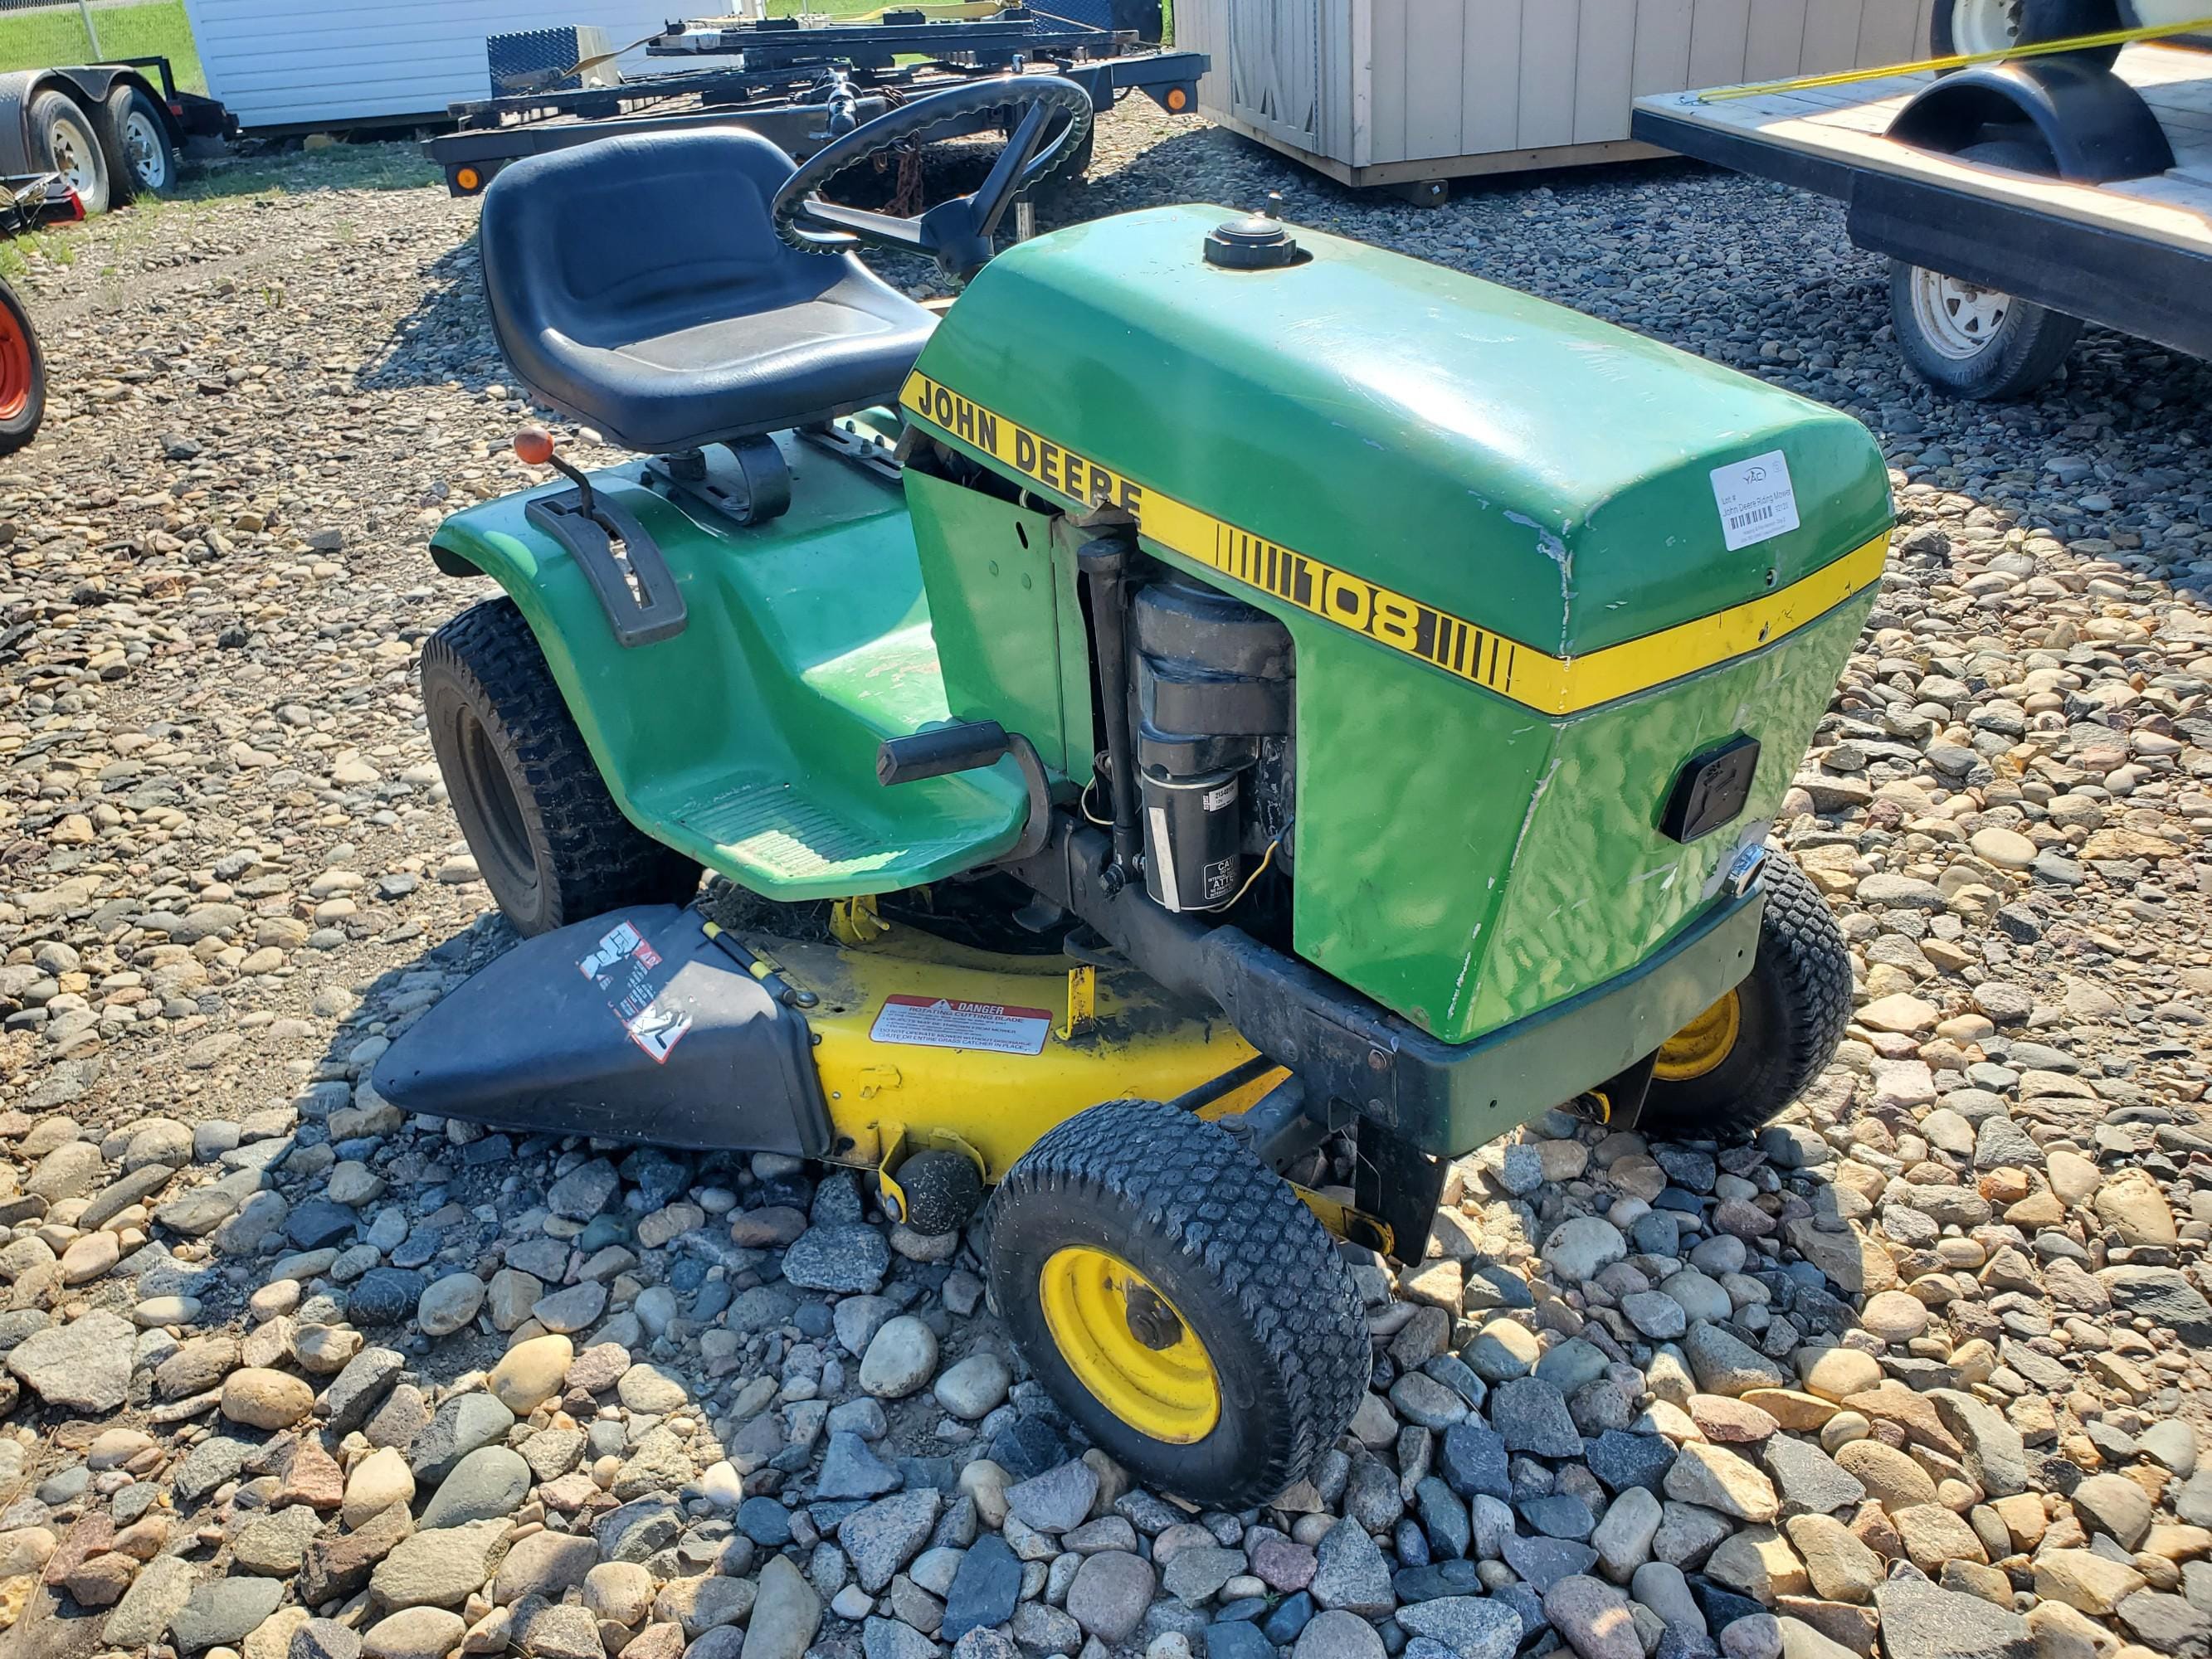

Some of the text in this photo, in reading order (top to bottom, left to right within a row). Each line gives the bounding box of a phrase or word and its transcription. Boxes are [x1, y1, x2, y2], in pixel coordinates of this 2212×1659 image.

[918, 379, 1143, 530] JOHN DEERE
[1722, 506, 1738, 518] John
[1738, 499, 1756, 512] Deere
[1303, 559, 1420, 651] 108
[909, 1007, 953, 1016] ROTATING
[954, 1011, 994, 1020] CUTTING
[995, 1014, 1023, 1024] BLADE
[957, 1002, 1005, 1015] DANGER
